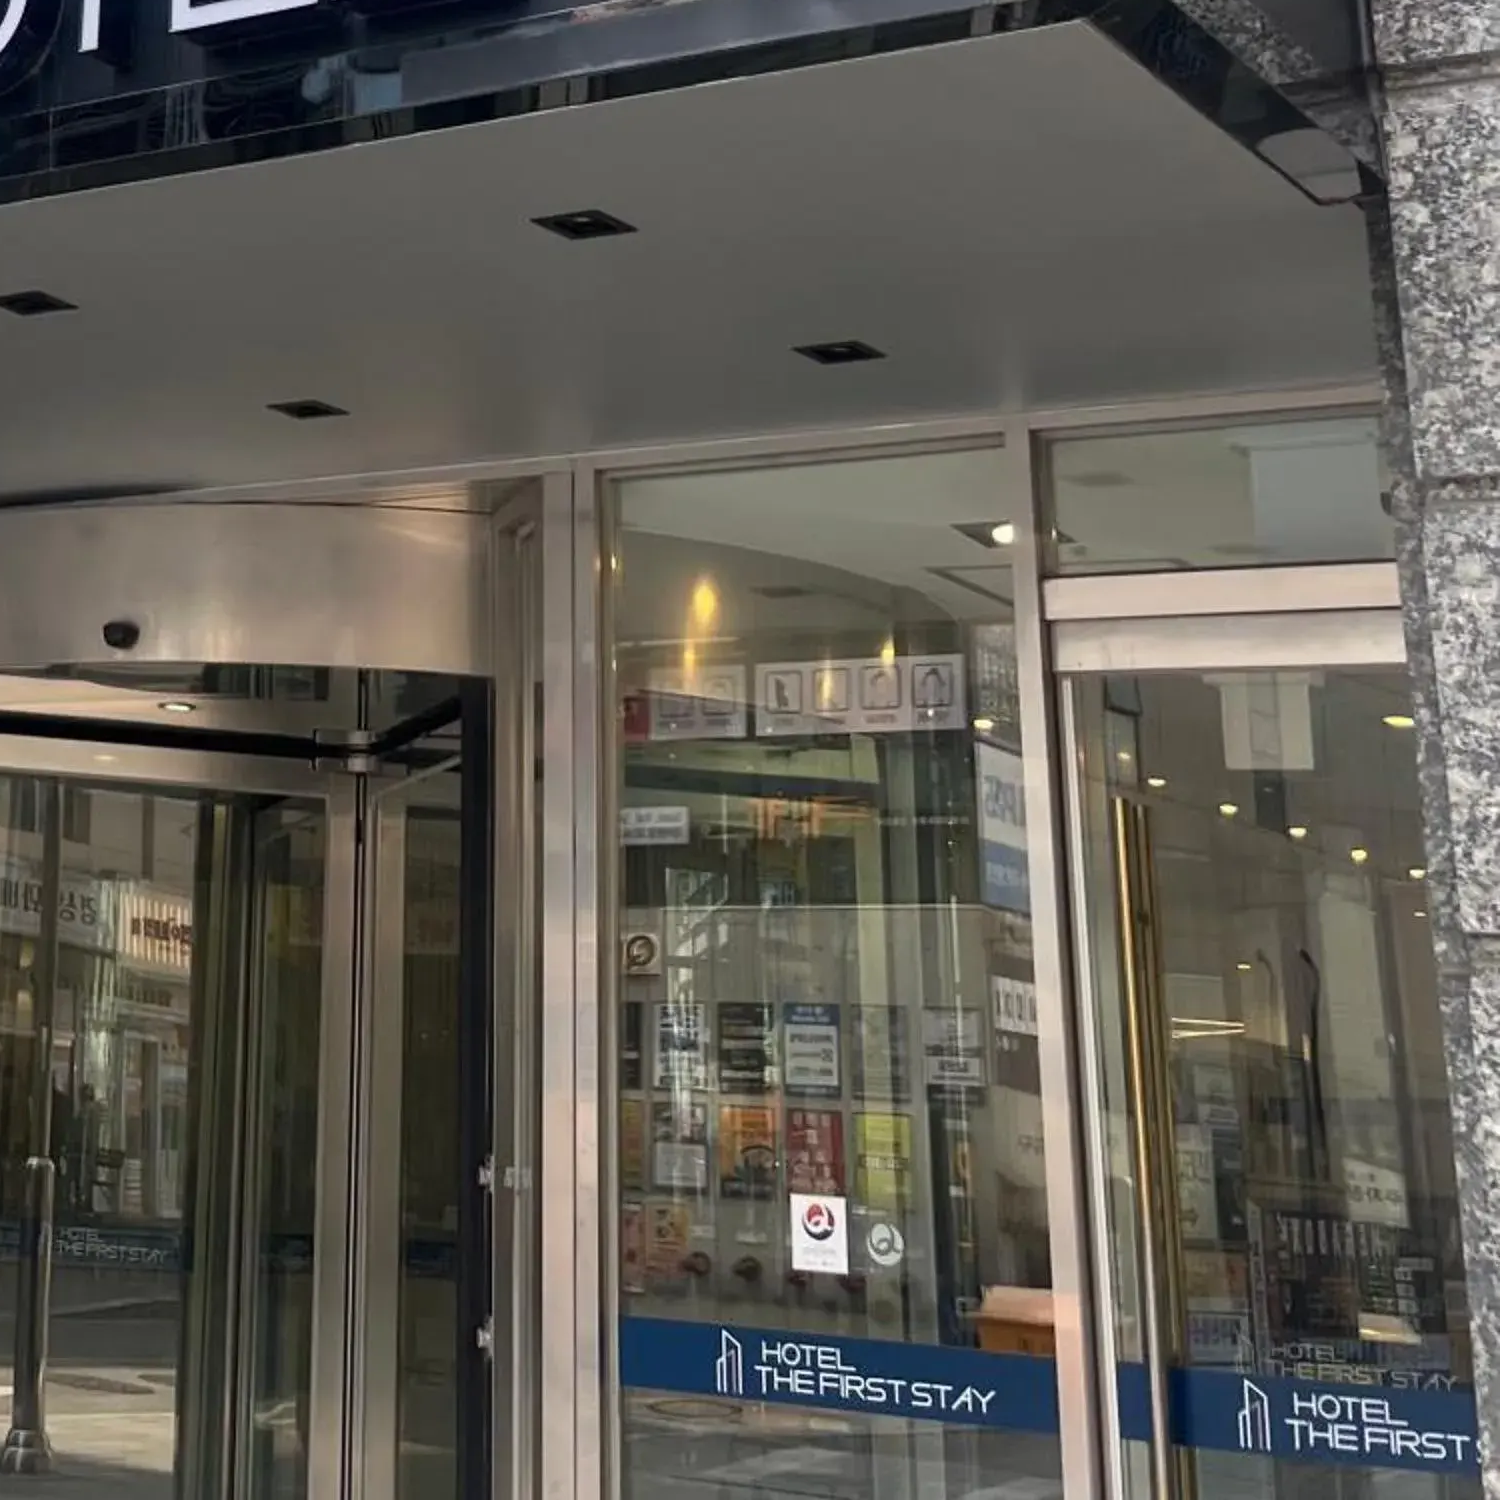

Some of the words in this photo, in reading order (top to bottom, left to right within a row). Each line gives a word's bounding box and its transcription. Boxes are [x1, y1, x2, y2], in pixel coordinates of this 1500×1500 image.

[761, 1340, 856, 1372] HOTEL
[754, 1365, 815, 1395] THE
[819, 1372, 907, 1405] FIRST
[911, 1382, 996, 1415] STAY
[1293, 1390, 1409, 1428] HOTEL
[1284, 1418, 1359, 1451] THE
[1363, 1426, 1471, 1462] FIRST
